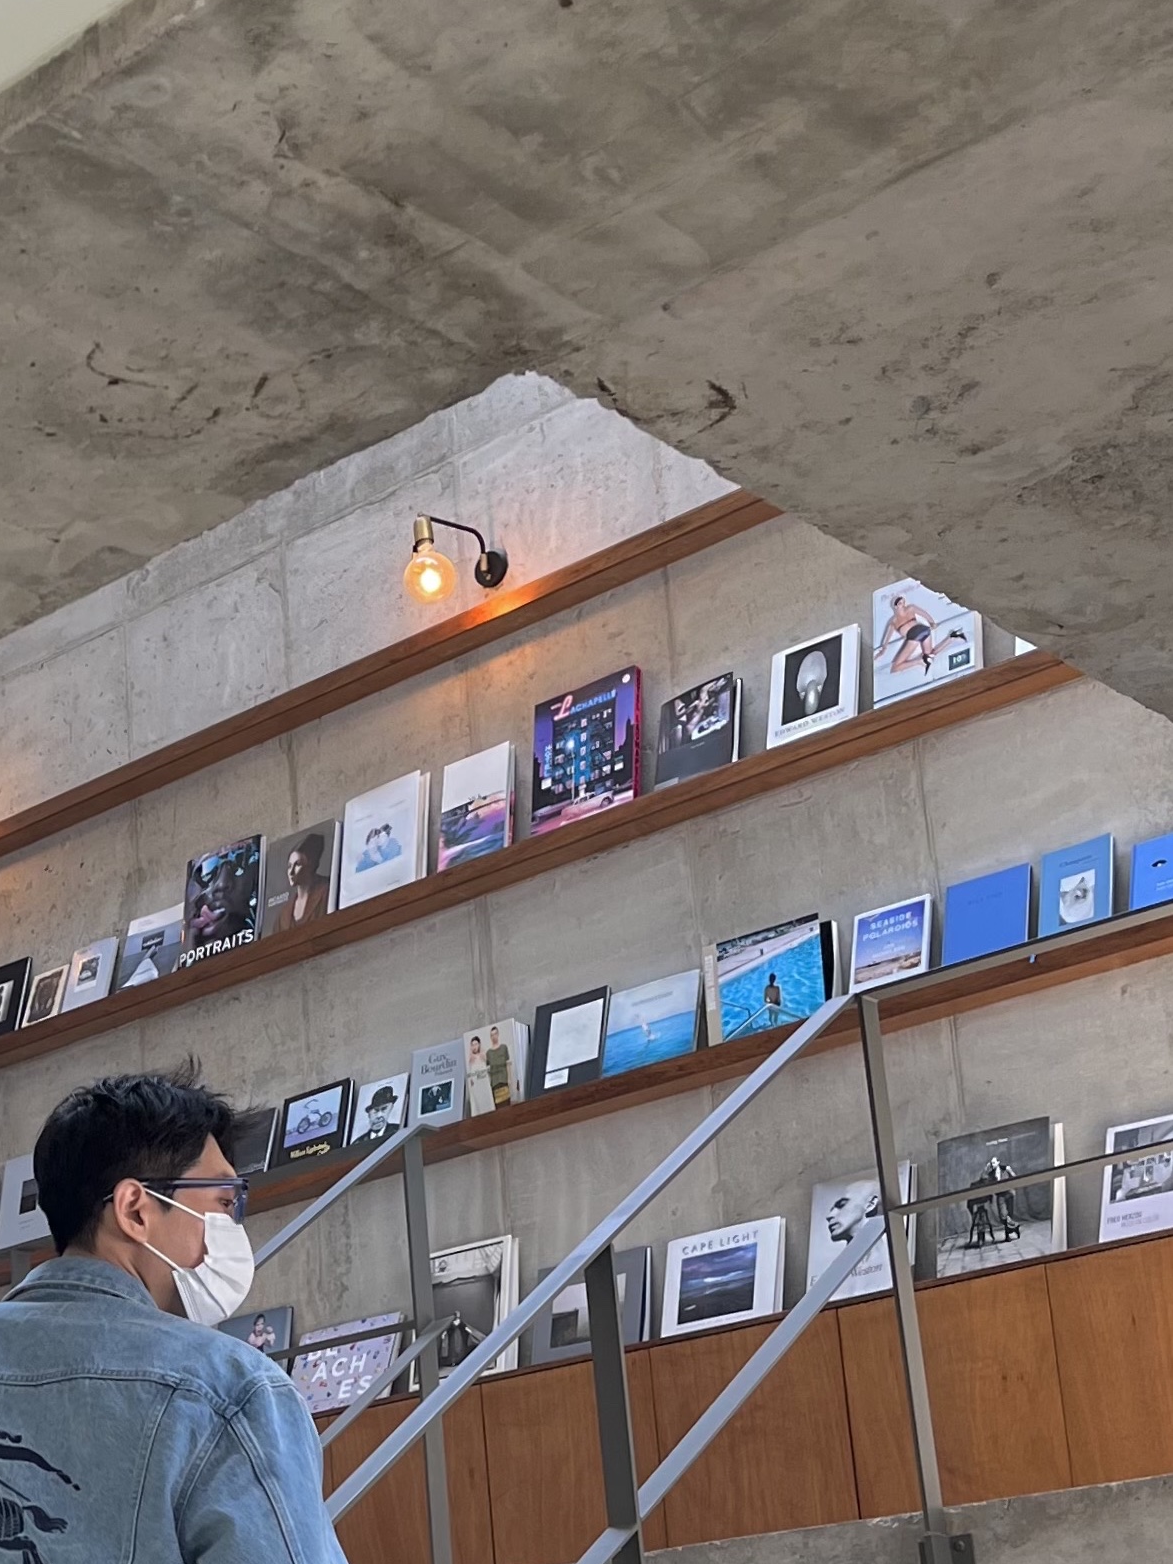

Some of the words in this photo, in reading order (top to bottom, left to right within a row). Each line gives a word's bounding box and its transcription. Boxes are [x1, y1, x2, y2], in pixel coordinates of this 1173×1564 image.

[774, 721, 810, 738] EDWARD
[811, 706, 846, 724] WESTON
[870, 911, 913, 930] SEASIDE
[178, 928, 255, 967] PORTRAITS
[682, 1240, 713, 1255] CAPE
[719, 1230, 759, 1247] LIGHT
[311, 1353, 367, 1383] ACH
[337, 1375, 373, 1399] ES
